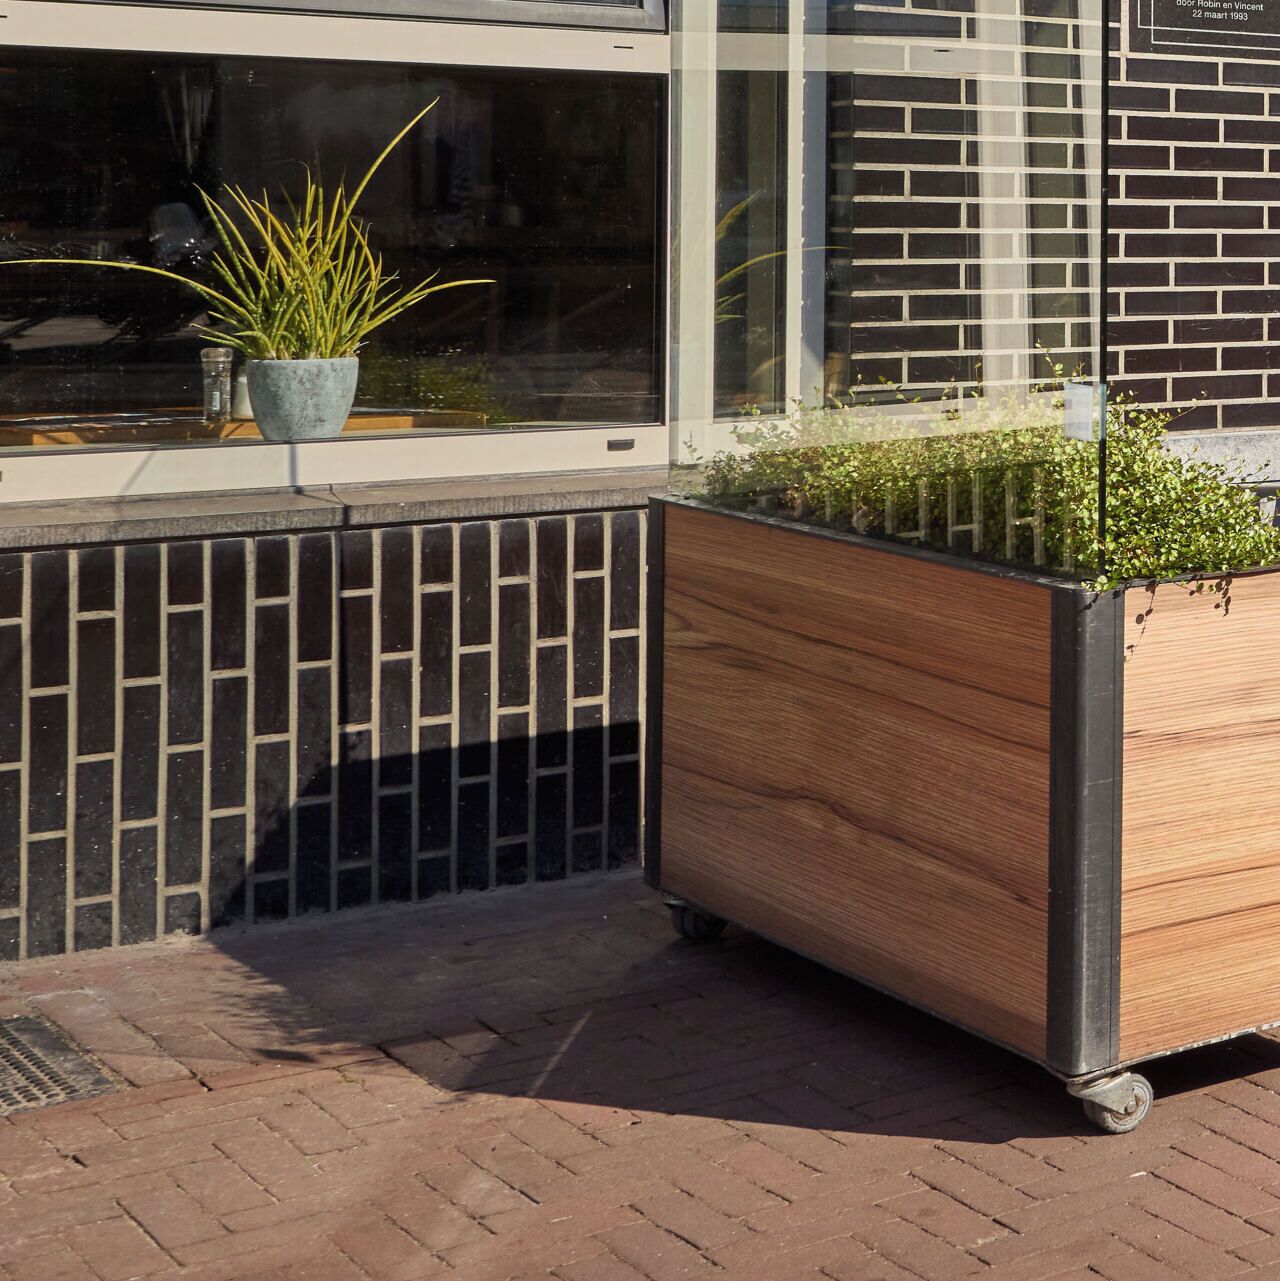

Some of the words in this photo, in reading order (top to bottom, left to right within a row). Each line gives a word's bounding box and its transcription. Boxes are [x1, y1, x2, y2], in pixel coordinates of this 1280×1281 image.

[1197, 0, 1221, 8] Robin
[1223, 2, 1233, 10] en
[1234, 2, 1264, 11] Vincent
[1192, 10, 1203, 18] 22
[1204, 11, 1228, 20] maart
[1230, 12, 1249, 20] 1993
